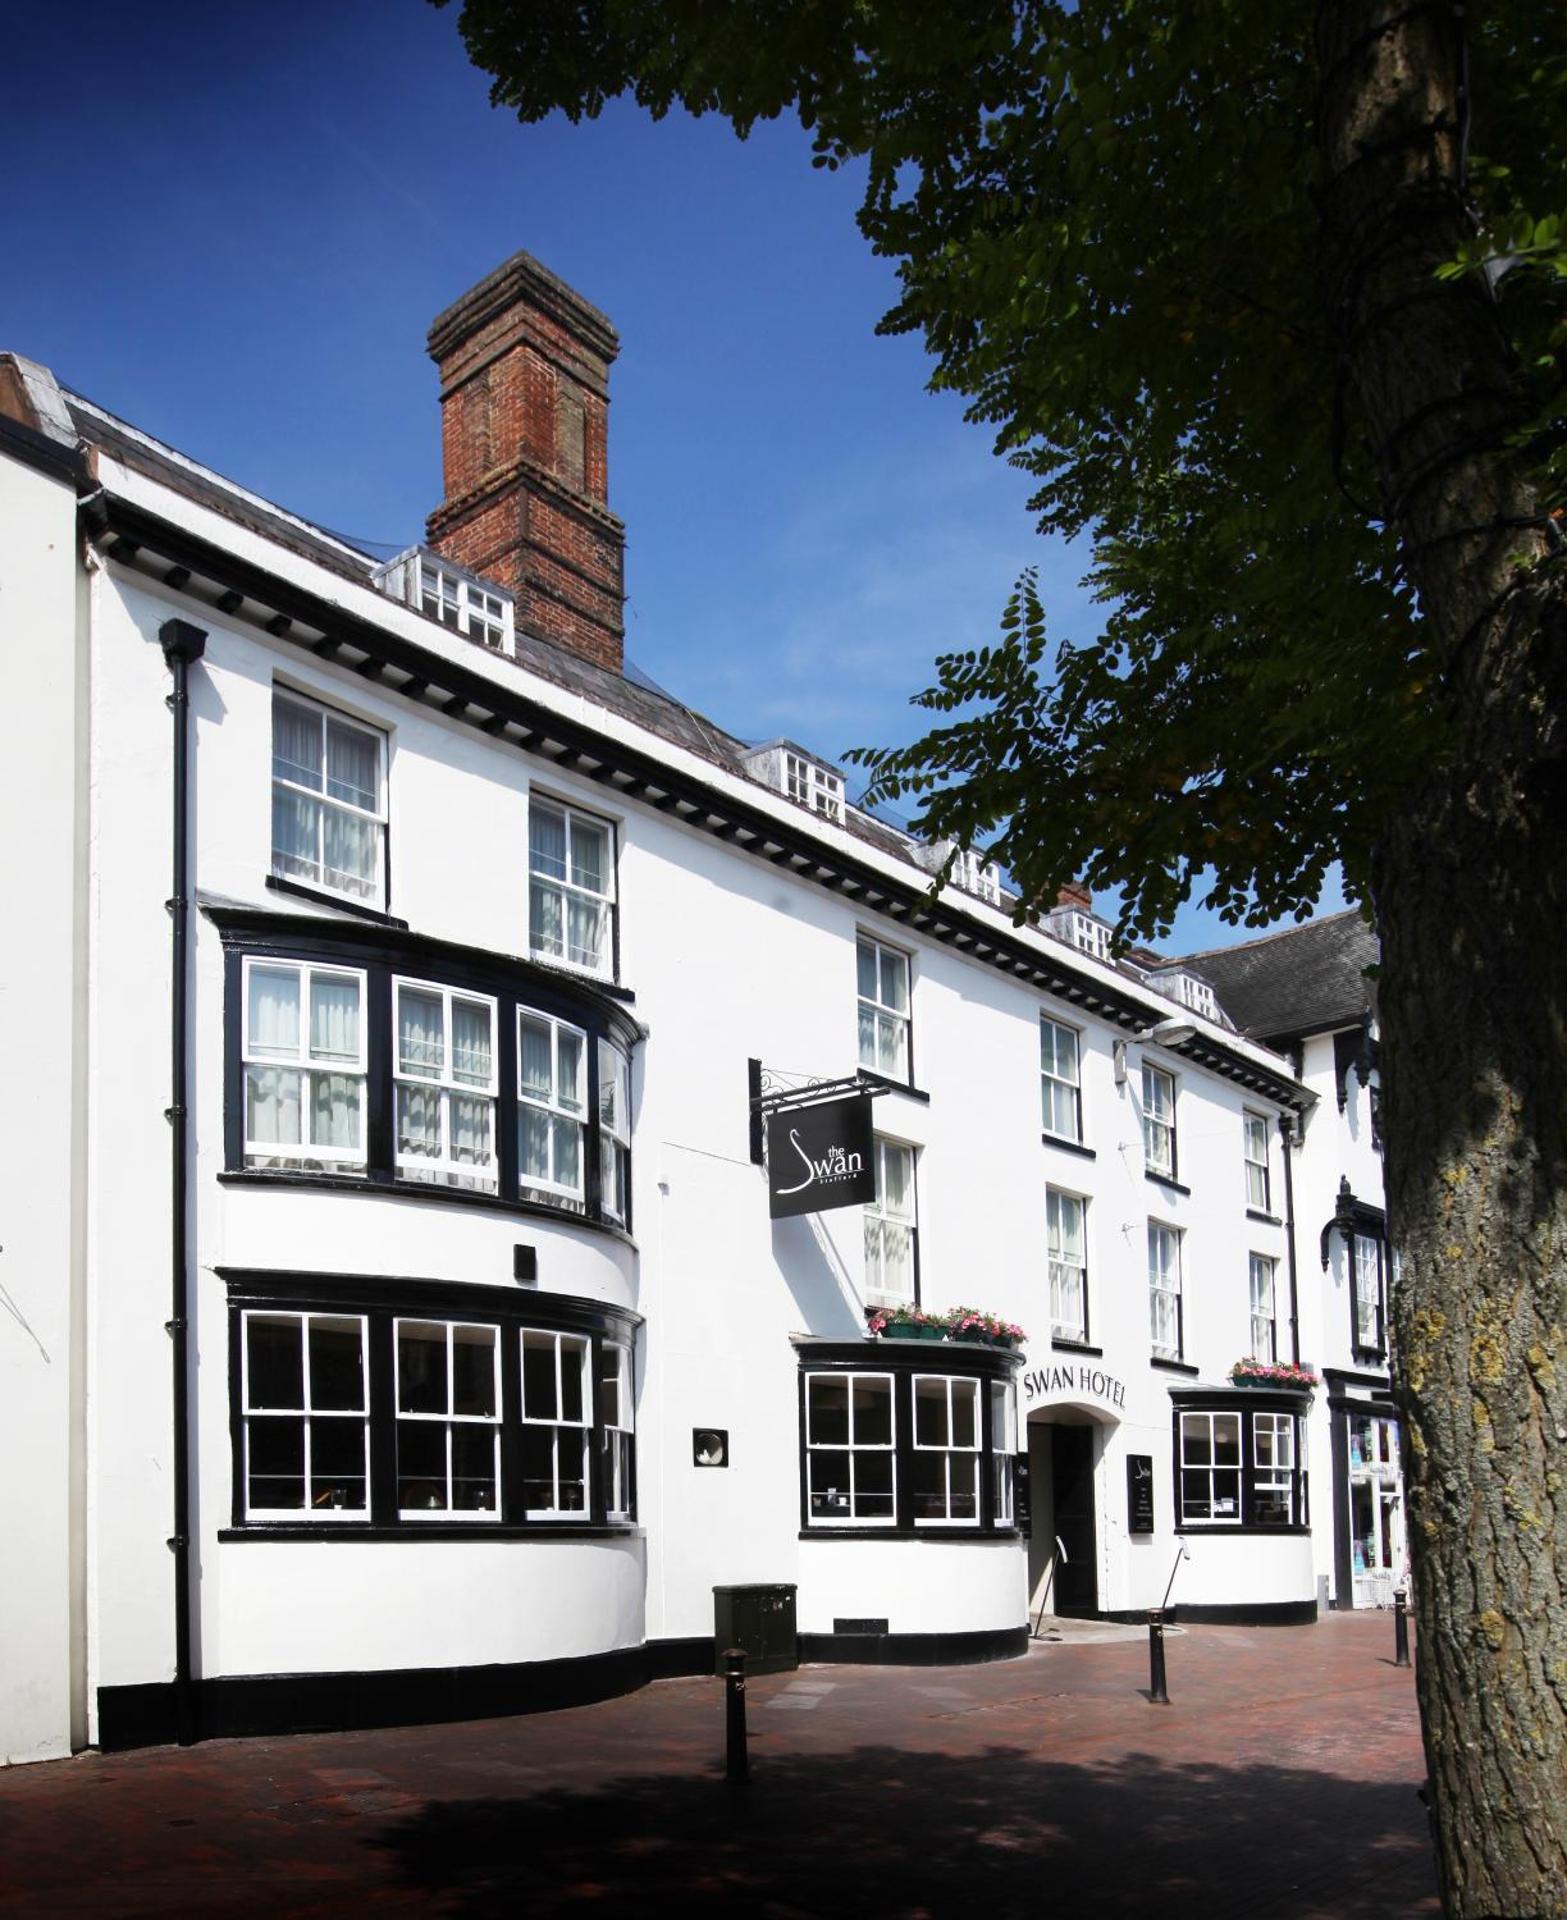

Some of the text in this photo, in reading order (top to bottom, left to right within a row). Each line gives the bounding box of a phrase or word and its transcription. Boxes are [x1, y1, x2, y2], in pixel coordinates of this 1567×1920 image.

[776, 1128, 862, 1194] Swan
[828, 1145, 845, 1158] the
[1024, 1365, 1126, 1410] SWAN HOTEL
